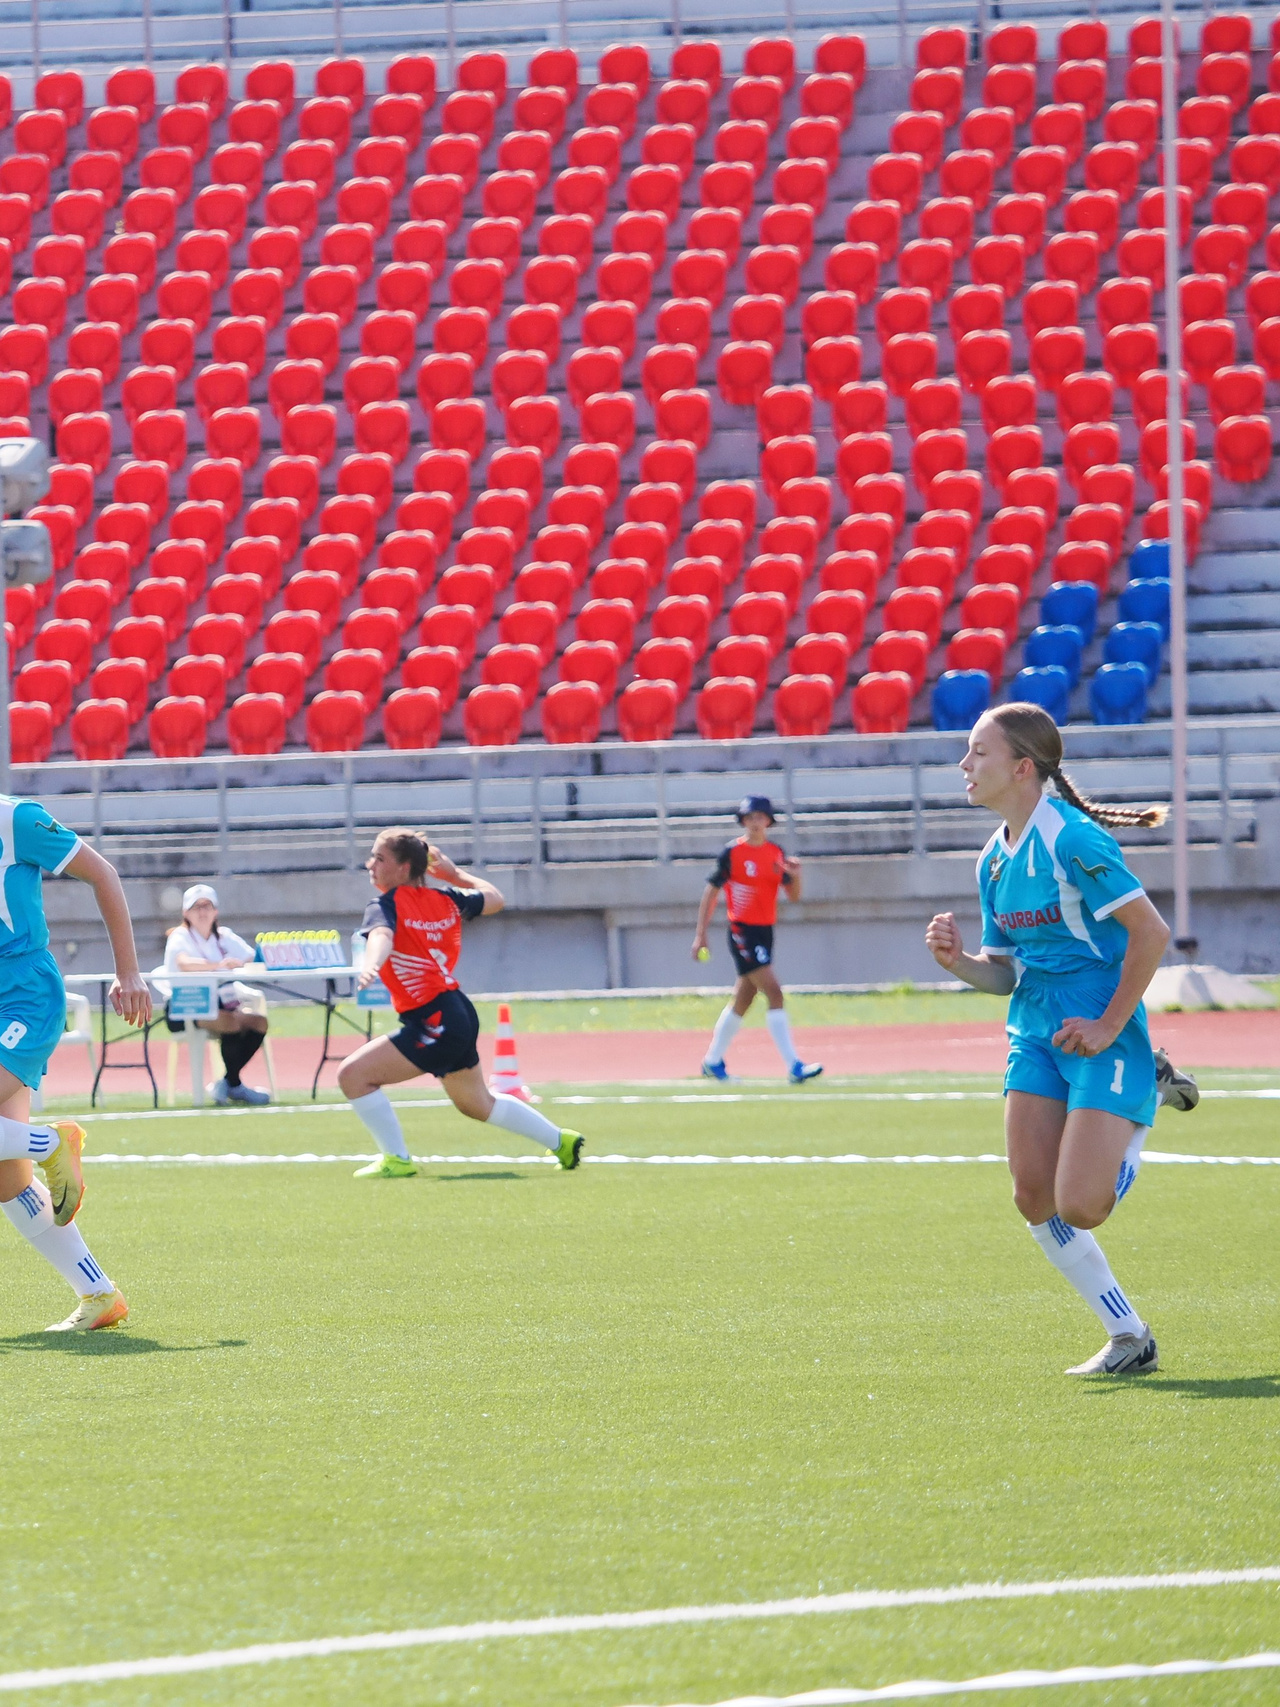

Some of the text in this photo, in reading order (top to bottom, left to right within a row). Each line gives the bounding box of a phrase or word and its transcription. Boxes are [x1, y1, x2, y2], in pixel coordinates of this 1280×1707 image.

[1027, 839, 1036, 877] 1
[0, 1021, 27, 1049] 8
[1110, 1059, 1125, 1095] 1
